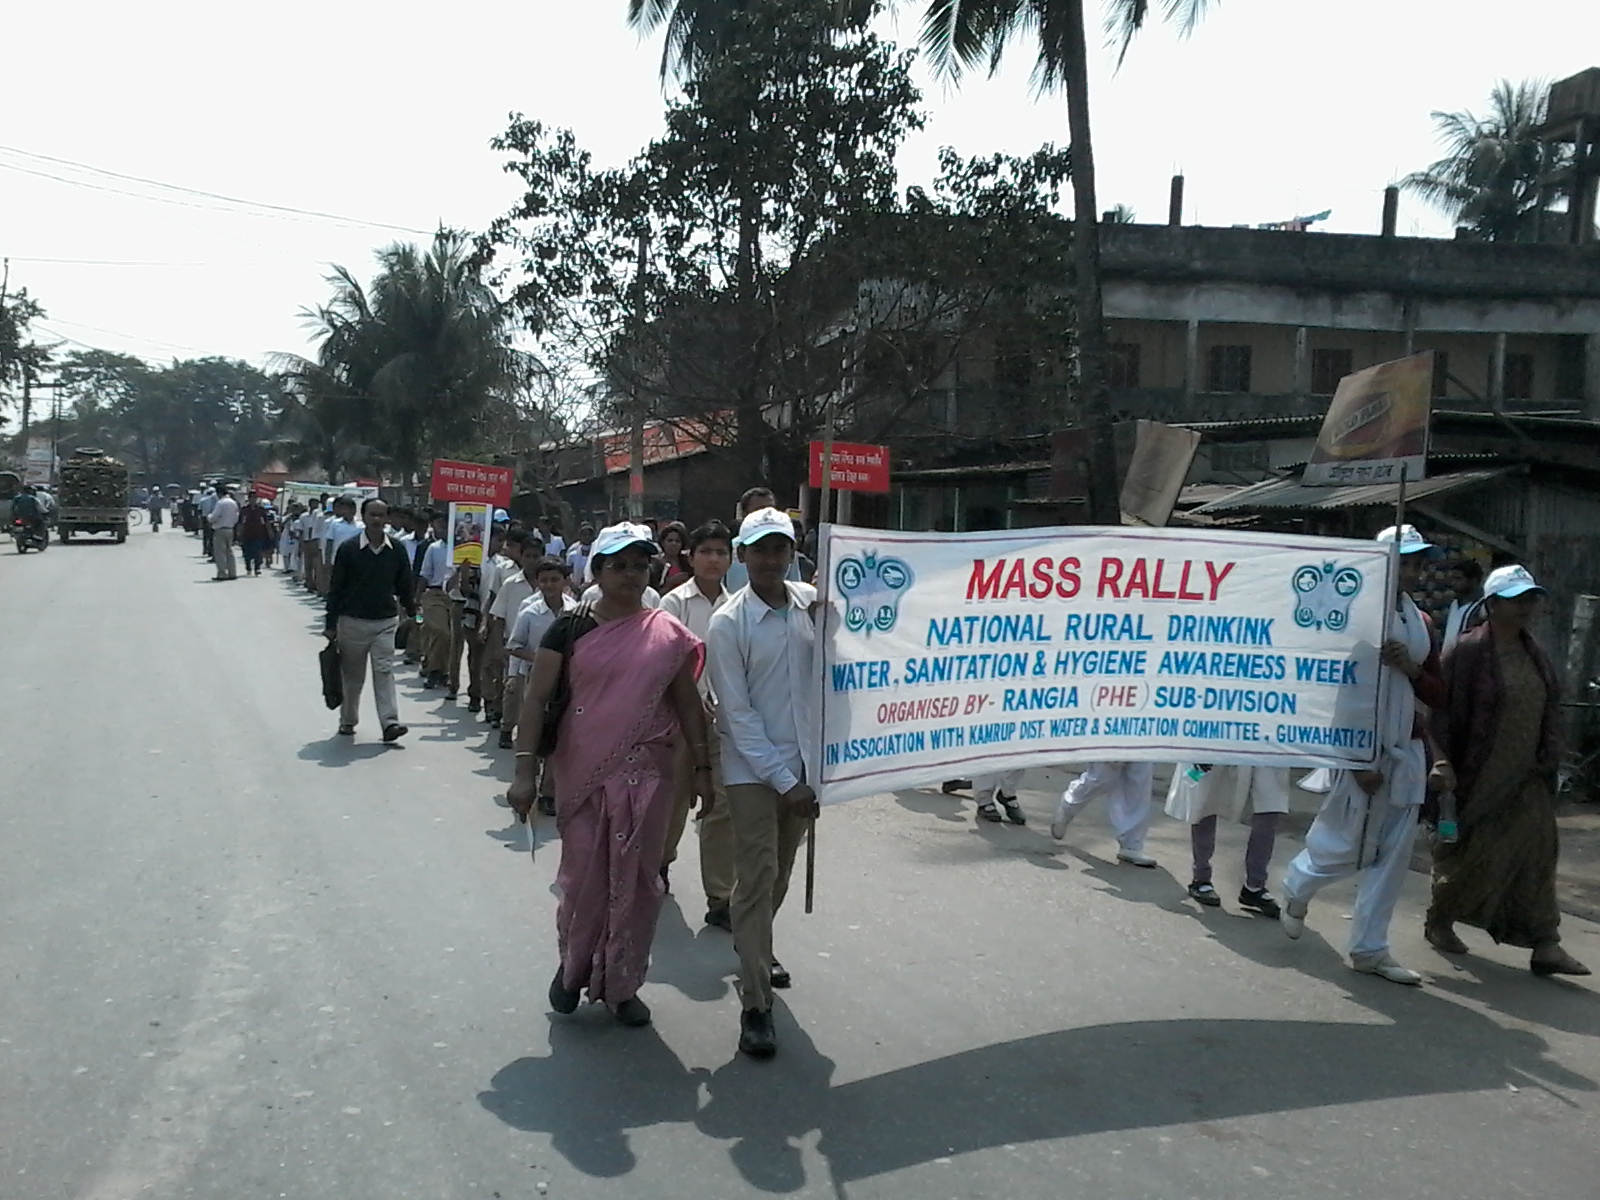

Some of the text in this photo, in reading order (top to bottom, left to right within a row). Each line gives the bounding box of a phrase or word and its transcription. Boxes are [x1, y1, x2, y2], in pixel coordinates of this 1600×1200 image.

[965, 556, 1237, 602] MASS RALLY
[926, 613, 1275, 647] NATIONAL RURAL DRINKINK
[904, 653, 1029, 685] SANITATION
[1032, 650, 1047, 676] &
[1053, 650, 1148, 676] HYGIENE
[1157, 651, 1286, 682] AWARENESS
[1295, 656, 1359, 685] WEEK
[877, 698, 959, 724] ORGANISED
[1002, 686, 1080, 712] RANGIA
[1091, 682, 1149, 713] (PHE)
[1154, 686, 1297, 715] SUB-DIVISION
[826, 742, 839, 765] IN
[843, 731, 925, 763] ASSOCIATION
[930, 726, 964, 748] WITH
[969, 723, 1016, 746] KAMRUP
[1019, 720, 1045, 740] DIST.
[1050, 719, 1087, 738] WATER
[1090, 718, 1099, 737] &
[1103, 717, 1179, 737] SANITATION
